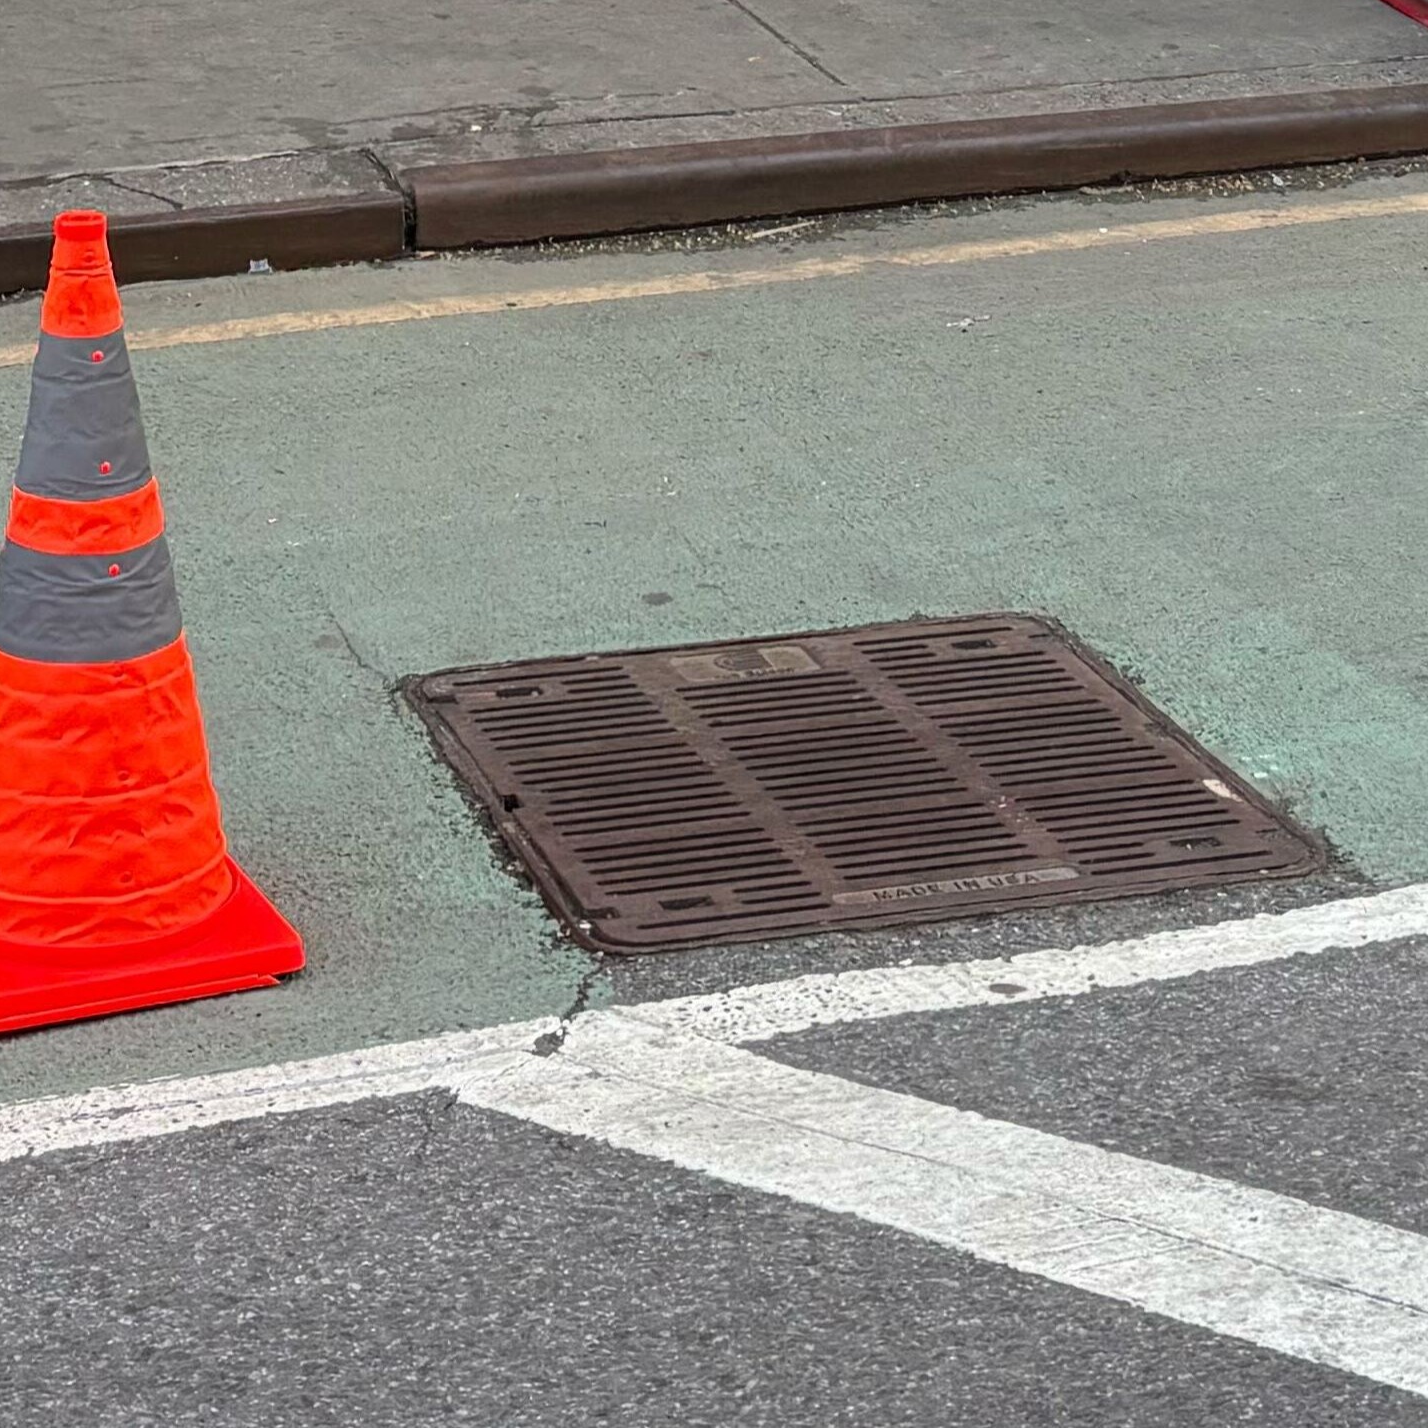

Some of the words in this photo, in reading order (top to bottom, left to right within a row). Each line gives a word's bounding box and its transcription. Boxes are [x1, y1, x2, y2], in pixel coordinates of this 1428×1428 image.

[872, 882, 943, 902] MADE
[953, 878, 979, 892] IN
[987, 871, 1041, 888] USA
